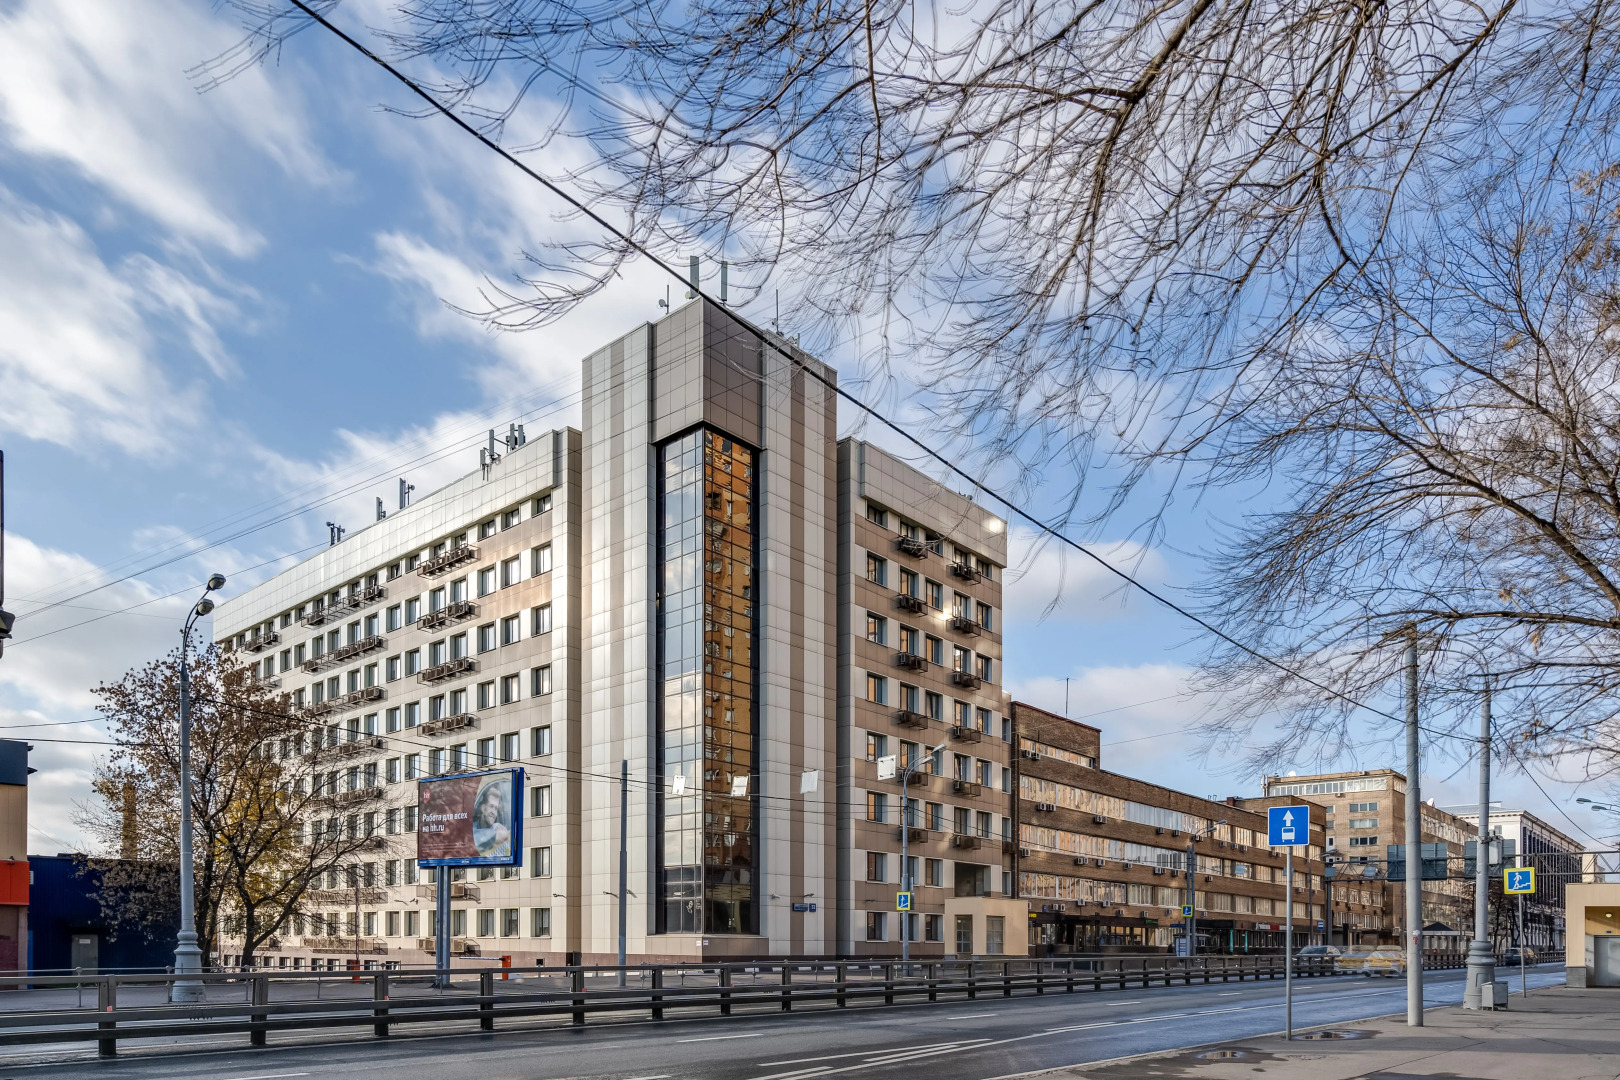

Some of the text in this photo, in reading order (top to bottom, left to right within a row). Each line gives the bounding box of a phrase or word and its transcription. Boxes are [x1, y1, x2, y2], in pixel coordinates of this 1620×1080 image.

[422, 814, 442, 822] Работа
[442, 813, 453, 822] для
[430, 824, 444, 832] hh.ru
